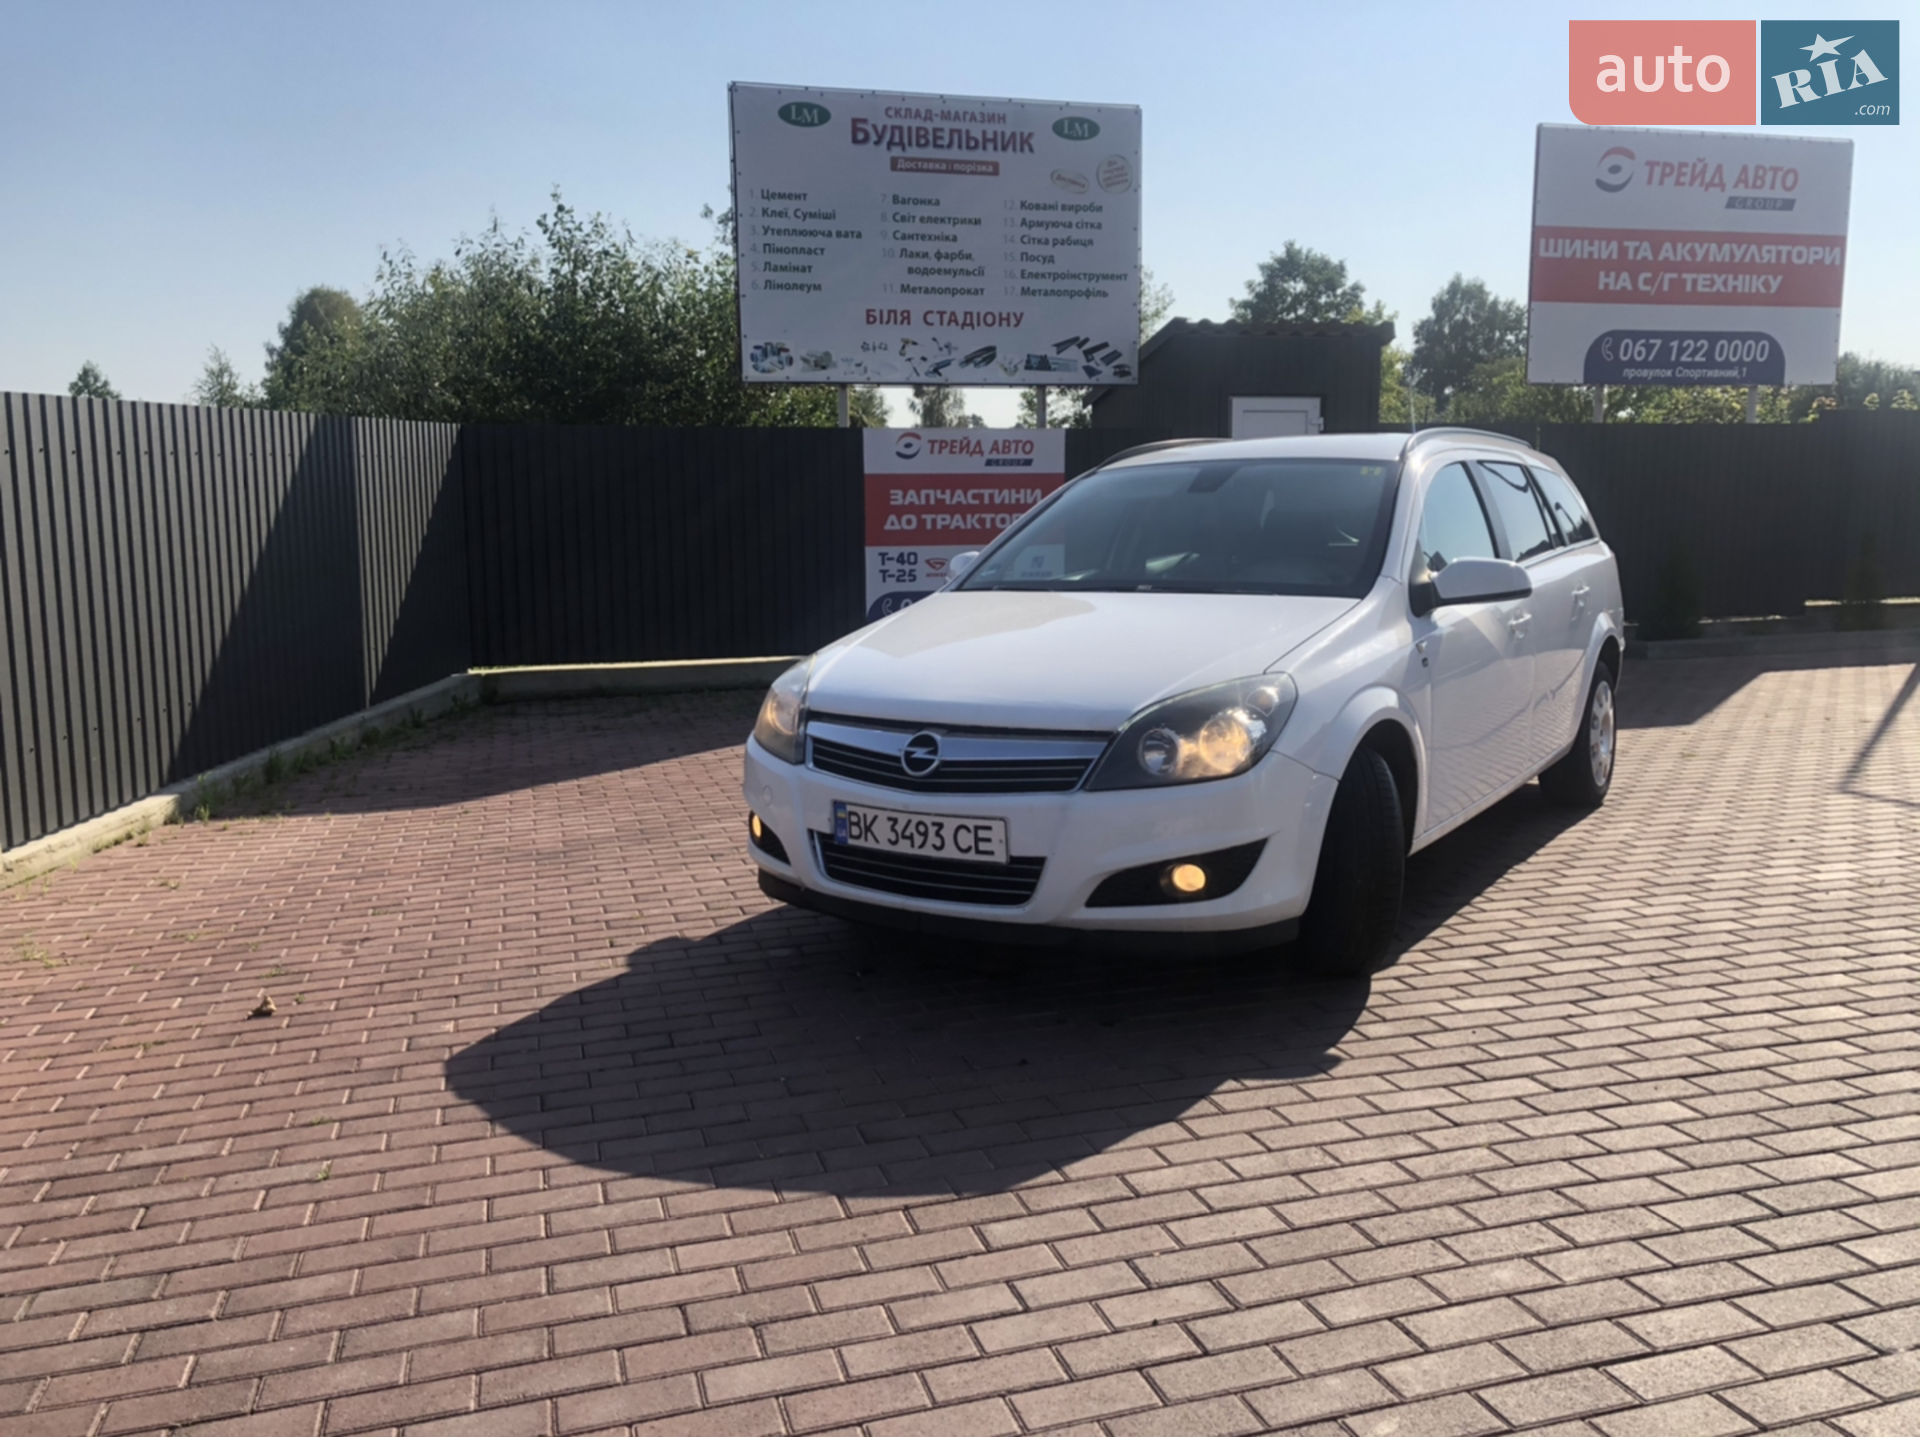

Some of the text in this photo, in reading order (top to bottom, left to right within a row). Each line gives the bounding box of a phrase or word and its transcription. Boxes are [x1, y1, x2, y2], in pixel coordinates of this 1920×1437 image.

[791, 105, 820, 125] LM
[884, 105, 1007, 125] СКЛАД-МАГАЗИН
[1063, 120, 1091, 138] LM
[896, 158, 947, 172] Доставка
[953, 163, 994, 175] порізка
[1644, 157, 1800, 193] ТРЕЙД АВТО
[749, 189, 808, 202] 1. Цемент
[892, 194, 941, 207] Вагонка
[1020, 201, 1059, 212] Ковані
[1060, 202, 1103, 214] вироби
[1735, 198, 1784, 210] GROUP
[749, 207, 837, 222] 2. Клеї, Суміші
[892, 212, 917, 223] Світ
[919, 215, 982, 228] електрики
[749, 224, 863, 239] 3. Утеплююча вата
[1020, 217, 1073, 231] Армуюча
[1075, 219, 1103, 230] сітка
[892, 230, 958, 243] Сантехніка
[1020, 234, 1050, 246] Сітка
[1052, 235, 1094, 248] рабиця
[749, 243, 826, 256] 4. Пінопласт
[899, 248, 932, 261] Лаки,
[933, 249, 975, 262] фарби,
[1538, 238, 1842, 266] ШИНИ ТА АКУМУЛЯТОРИ
[1020, 252, 1055, 265] Посуд
[751, 261, 813, 274] 5. Ламінат
[907, 266, 986, 279] водоемульсії
[1020, 268, 1129, 283] Електроінструмент
[751, 279, 822, 294] 6. Лінолеум
[900, 283, 985, 298] Металопрокат
[1598, 271, 1784, 296] НА С/Г ТЕХНІКУ
[1020, 287, 1109, 300] Металопрофіль
[865, 308, 1025, 330] БІЛЯ СТАДІОНУ
[1618, 338, 1770, 363] 067 122 0000
[1622, 368, 1673, 380] провулок
[927, 436, 1035, 458] ТРЕЙД АВТО
[889, 488, 1042, 506] ЗАПЧАСТИНИ
[883, 513, 918, 531] ДО
[878, 551, 918, 567] Т-40
[878, 568, 917, 583] Т-25
[848, 810, 996, 857] BK 3493 CE
